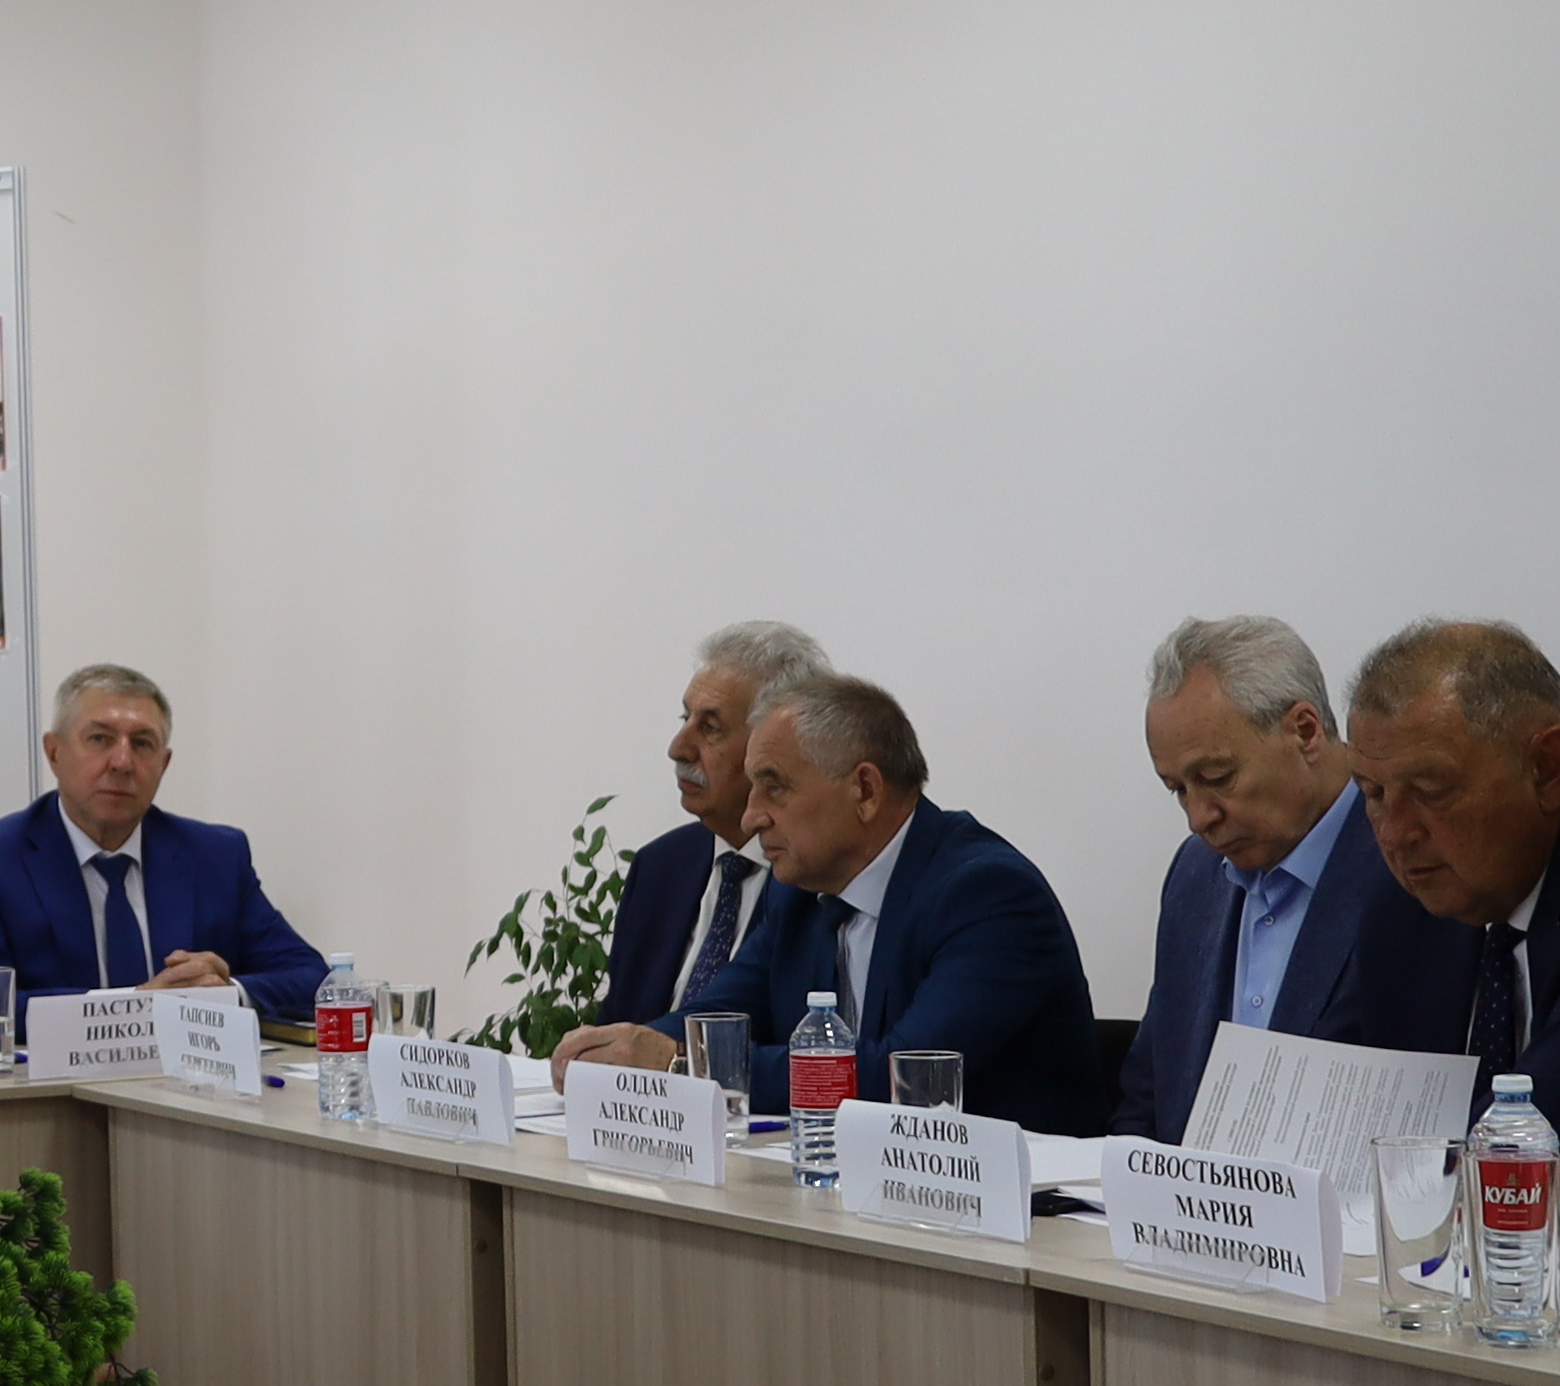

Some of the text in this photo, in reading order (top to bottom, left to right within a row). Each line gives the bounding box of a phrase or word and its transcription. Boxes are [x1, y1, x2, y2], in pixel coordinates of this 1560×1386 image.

[82, 997, 153, 1018] ПАСТУ
[179, 1004, 225, 1028] ТАПСИЕВ
[86, 1020, 155, 1042] НИКОЛ
[188, 1031, 221, 1052] ИГОРЬ
[69, 1045, 160, 1067] ВАСИЛЬЕ
[399, 1043, 471, 1069] СИДОРКОВ
[400, 1071, 477, 1099] АЛЕКСАНДР
[616, 1072, 668, 1098] ОЛДАК
[406, 1098, 478, 1126] ПАВЛОВИЧ
[598, 1100, 685, 1132] АЛЕКСАНДР
[890, 1114, 969, 1145] ЖДАНОВ
[592, 1128, 694, 1164] ГРИГОРЬЕВИЧ
[881, 1146, 982, 1183] АНАТОЛИЙ
[1127, 1149, 1297, 1199] СЕВОСТЬЯНОВА
[883, 1179, 983, 1218] ИВАНОВИЧ
[1484, 1181, 1542, 1205] КУБАЙ
[1174, 1194, 1255, 1228] МАРИЯ
[1132, 1221, 1307, 1278] ВЛАДИМИРОВНА
